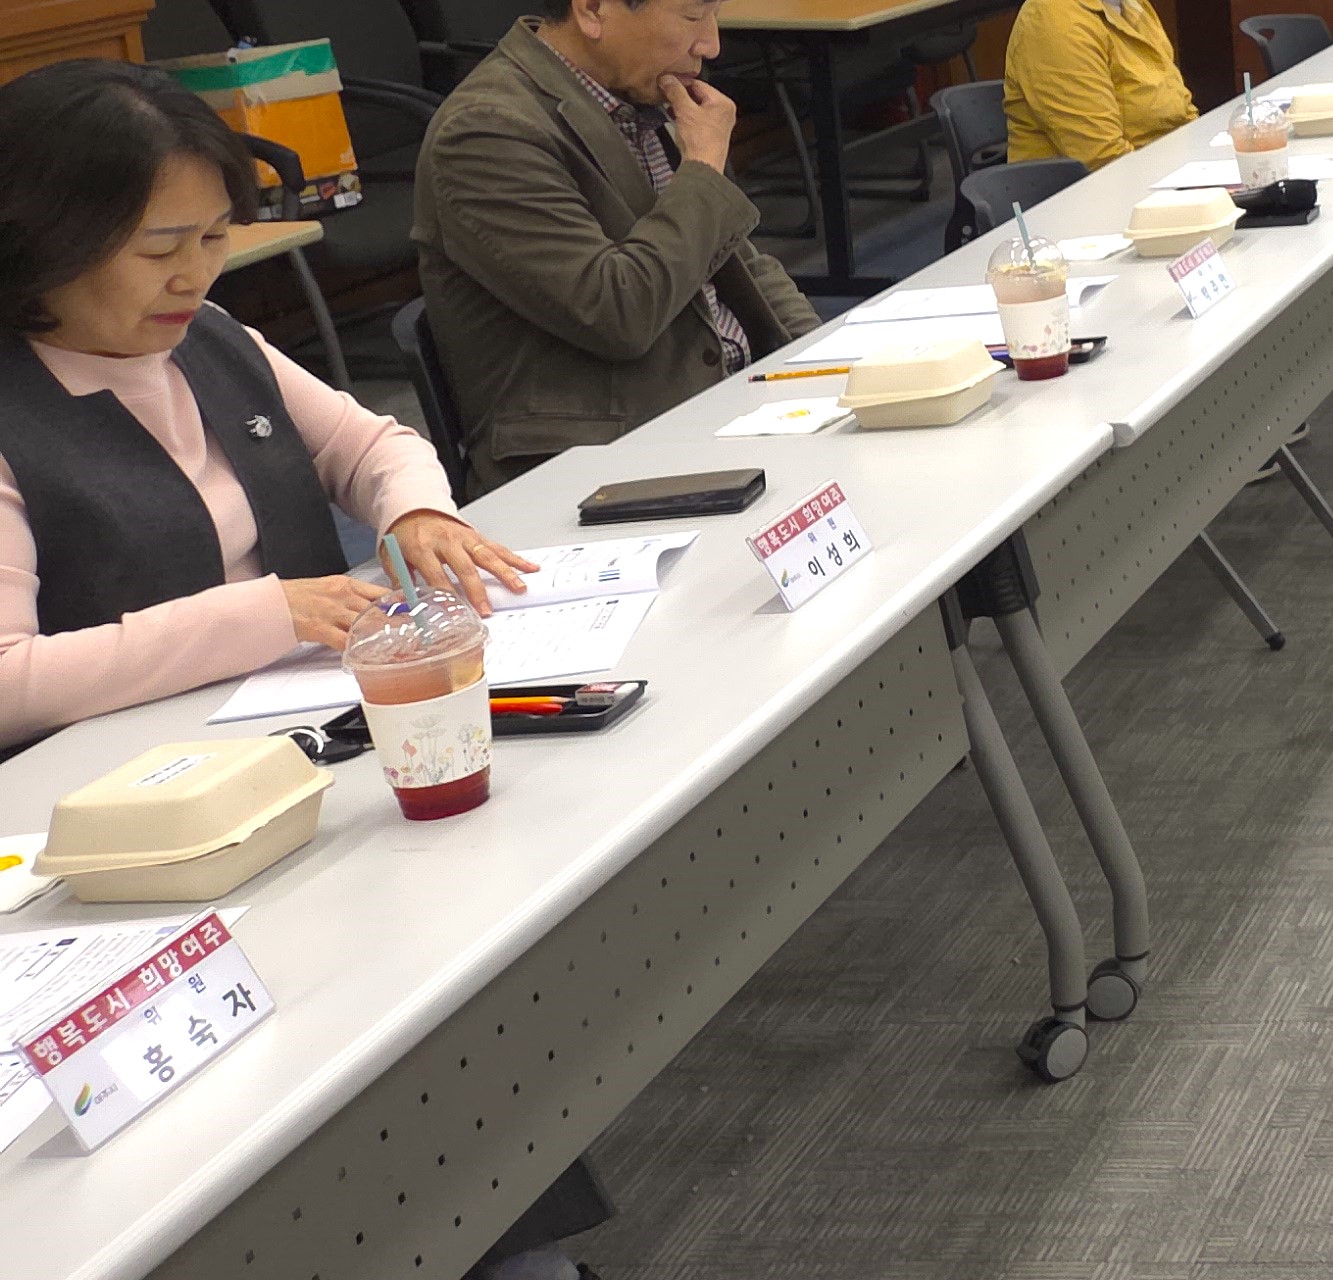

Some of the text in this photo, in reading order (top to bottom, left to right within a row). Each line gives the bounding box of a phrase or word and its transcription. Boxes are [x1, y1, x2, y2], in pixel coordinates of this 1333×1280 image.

[756, 486, 843, 556] 행복도시 희망여주
[807, 529, 861, 577] 이성희
[32, 987, 133, 1066] 행복도시
[137, 922, 223, 993] 희망여주
[142, 982, 257, 1083] 홍숙자
